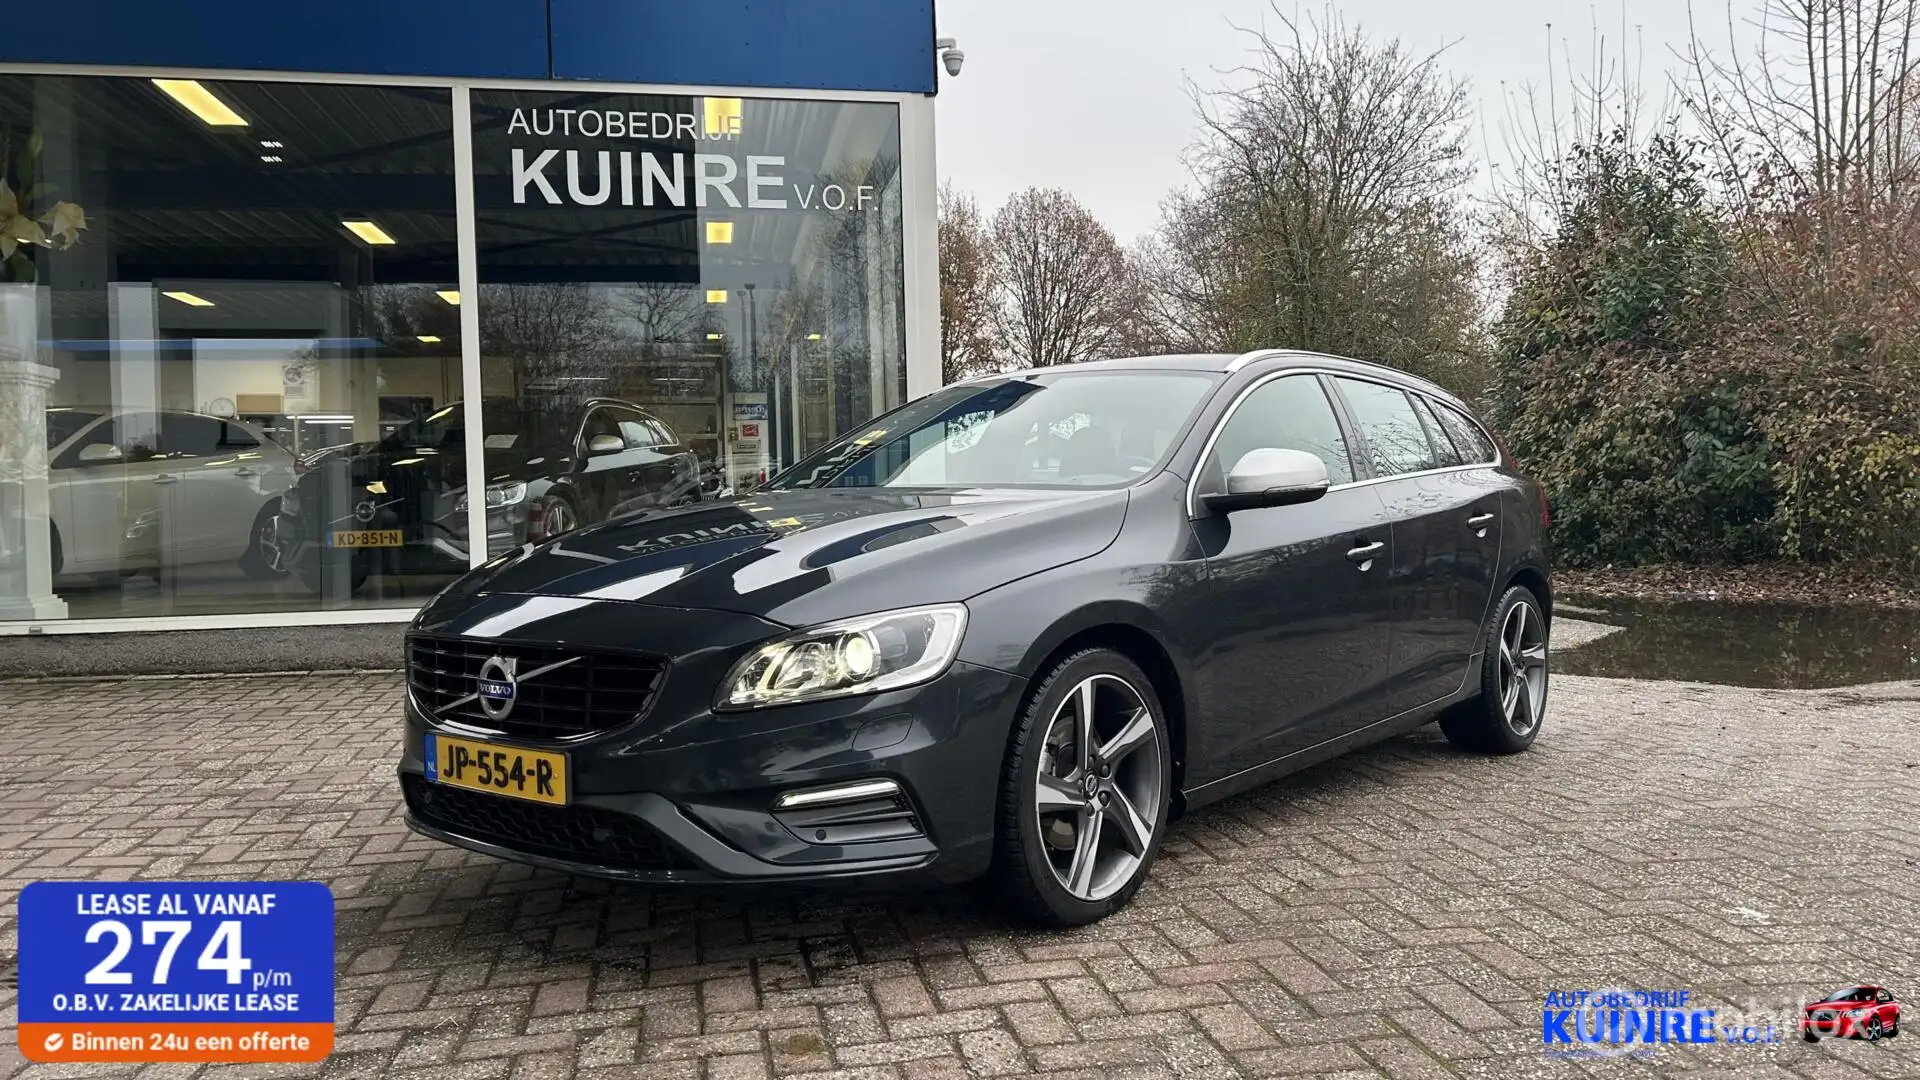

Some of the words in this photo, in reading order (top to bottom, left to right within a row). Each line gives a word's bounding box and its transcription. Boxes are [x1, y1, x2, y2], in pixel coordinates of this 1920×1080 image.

[507, 108, 743, 142] AUTOBEDRIJF
[511, 148, 788, 210] KUINRE
[793, 183, 879, 212] V.O.F.
[338, 531, 398, 546] KD-851-N
[479, 683, 511, 695] VOLVO
[443, 744, 554, 797] JP-554-R
